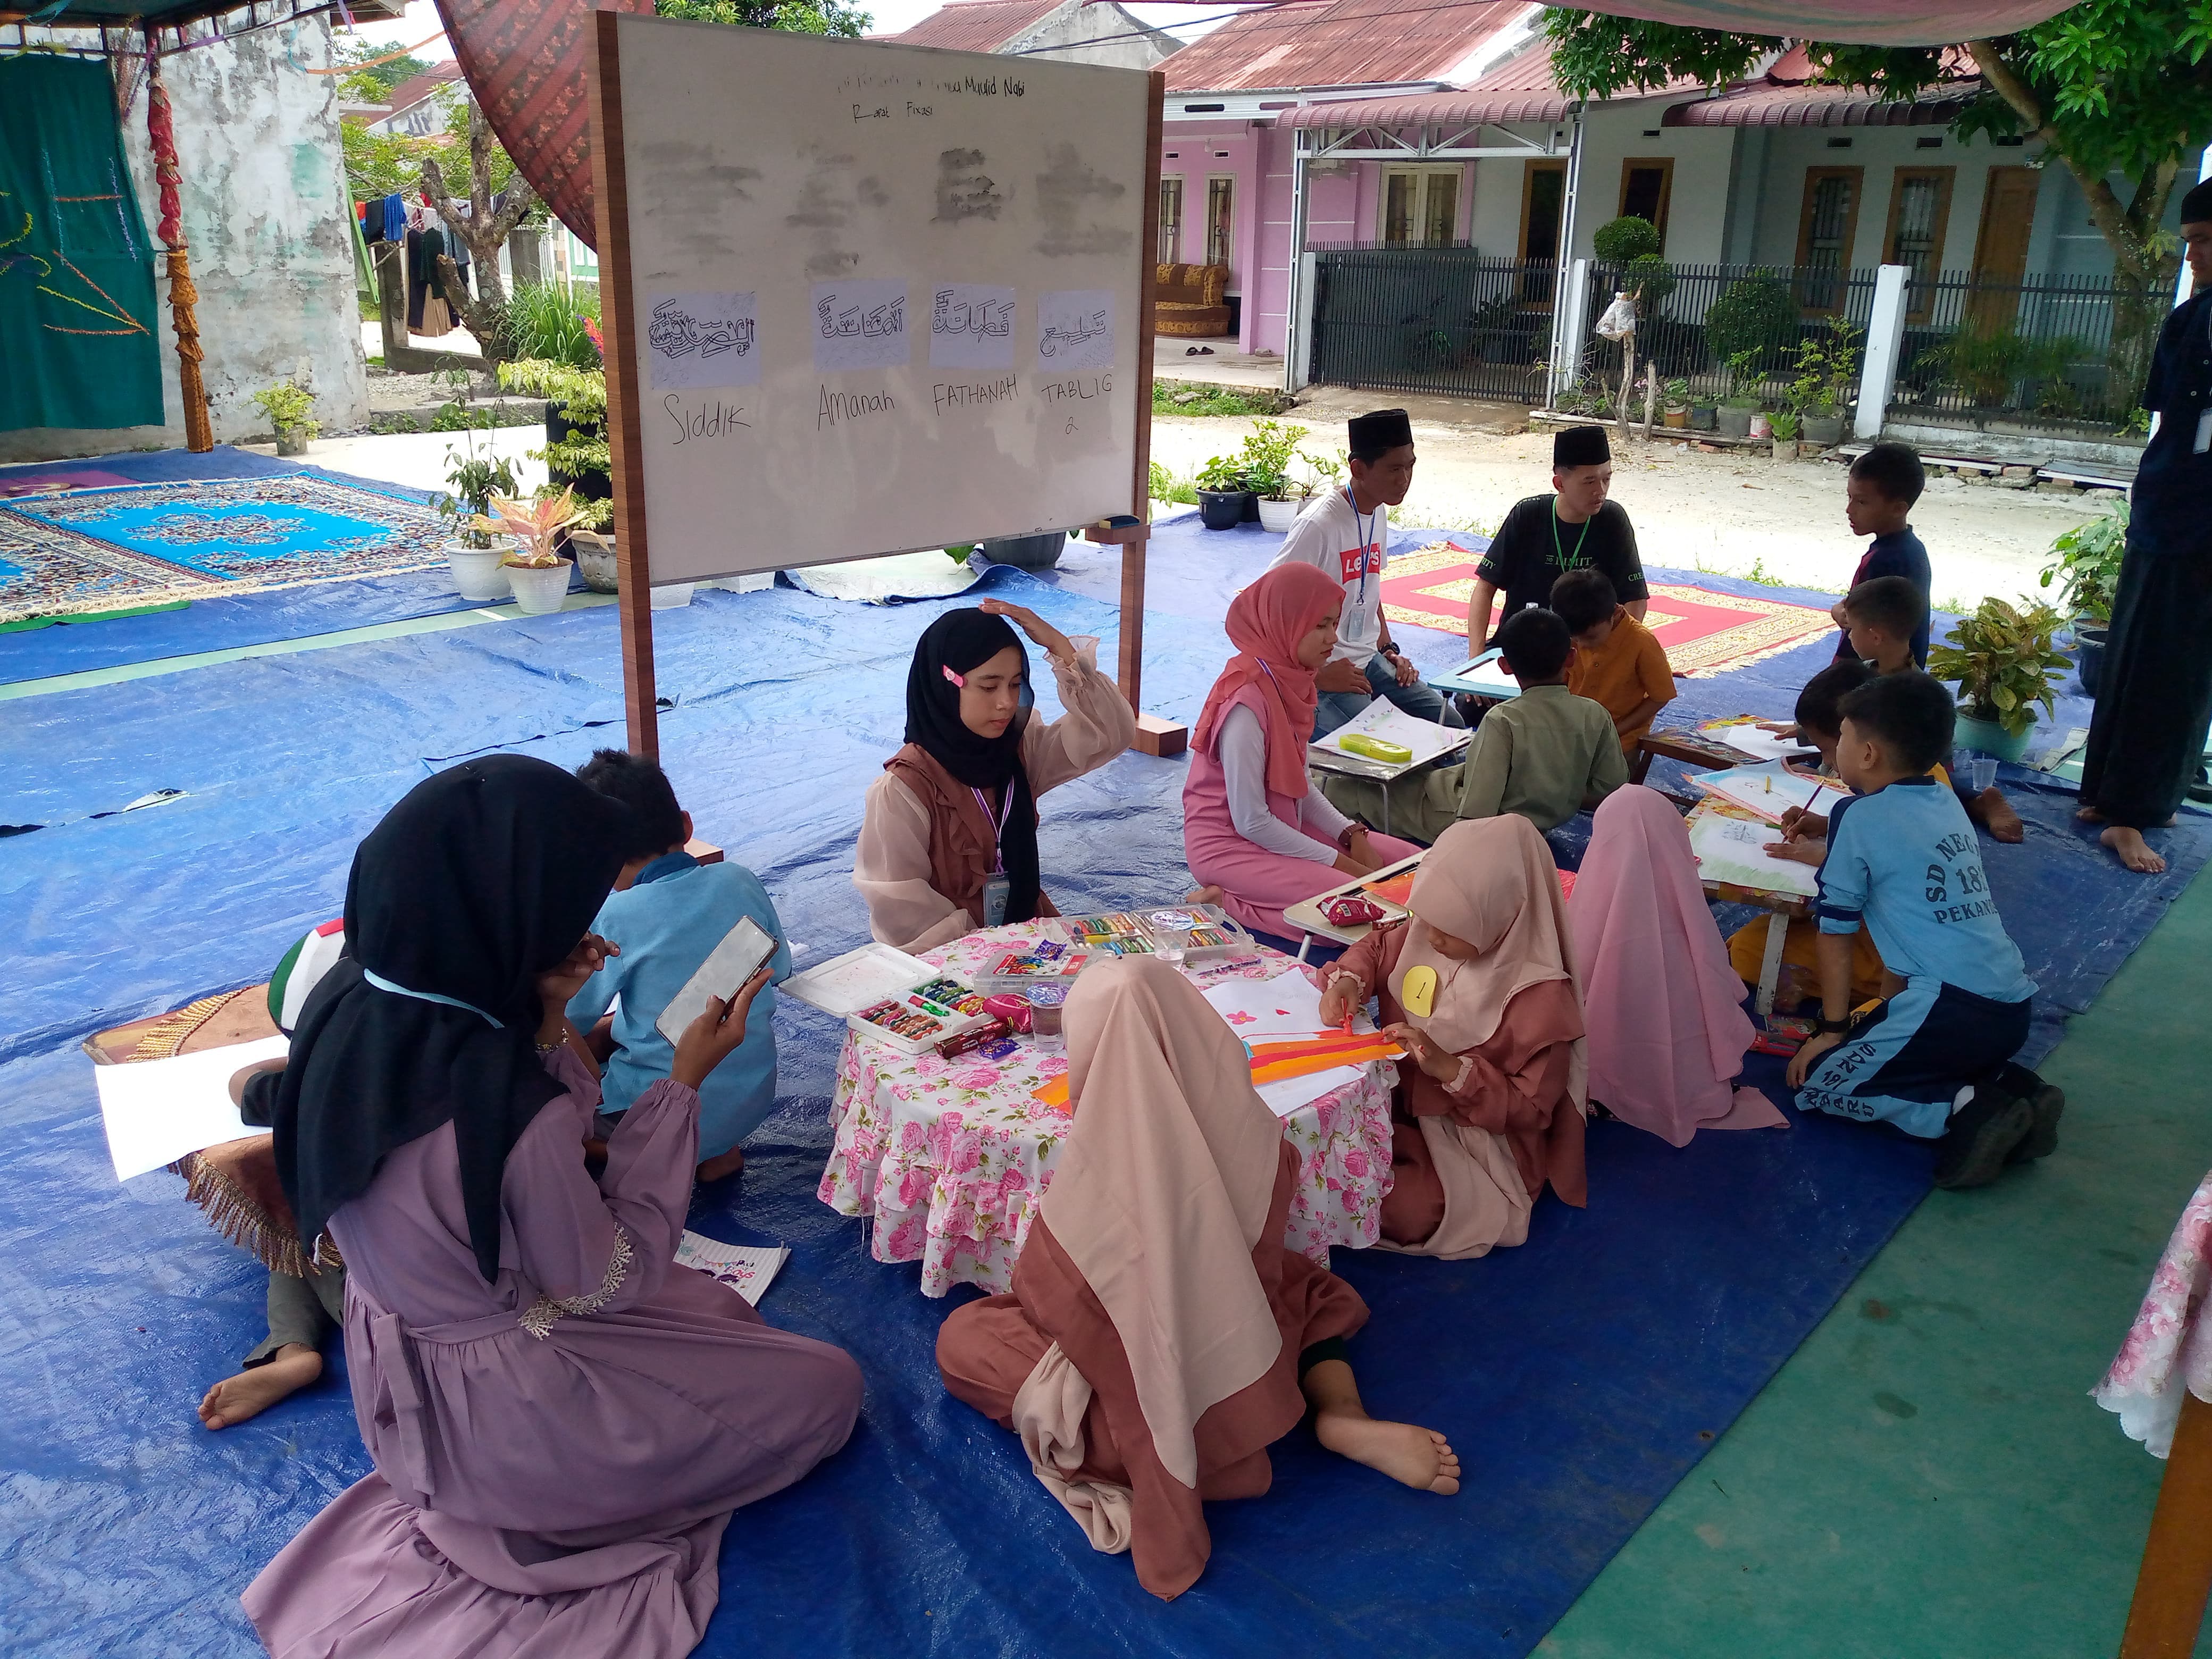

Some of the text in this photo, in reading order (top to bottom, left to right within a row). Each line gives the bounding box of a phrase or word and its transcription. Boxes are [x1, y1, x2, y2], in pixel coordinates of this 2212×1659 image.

[1004, 76, 1025, 97] Nabi
[933, 373, 1018, 416] FATHANAH
[1041, 373, 1113, 408] TABLIG
[1925, 864, 1947, 903] SD
[1415, 982, 1427, 999] 1
